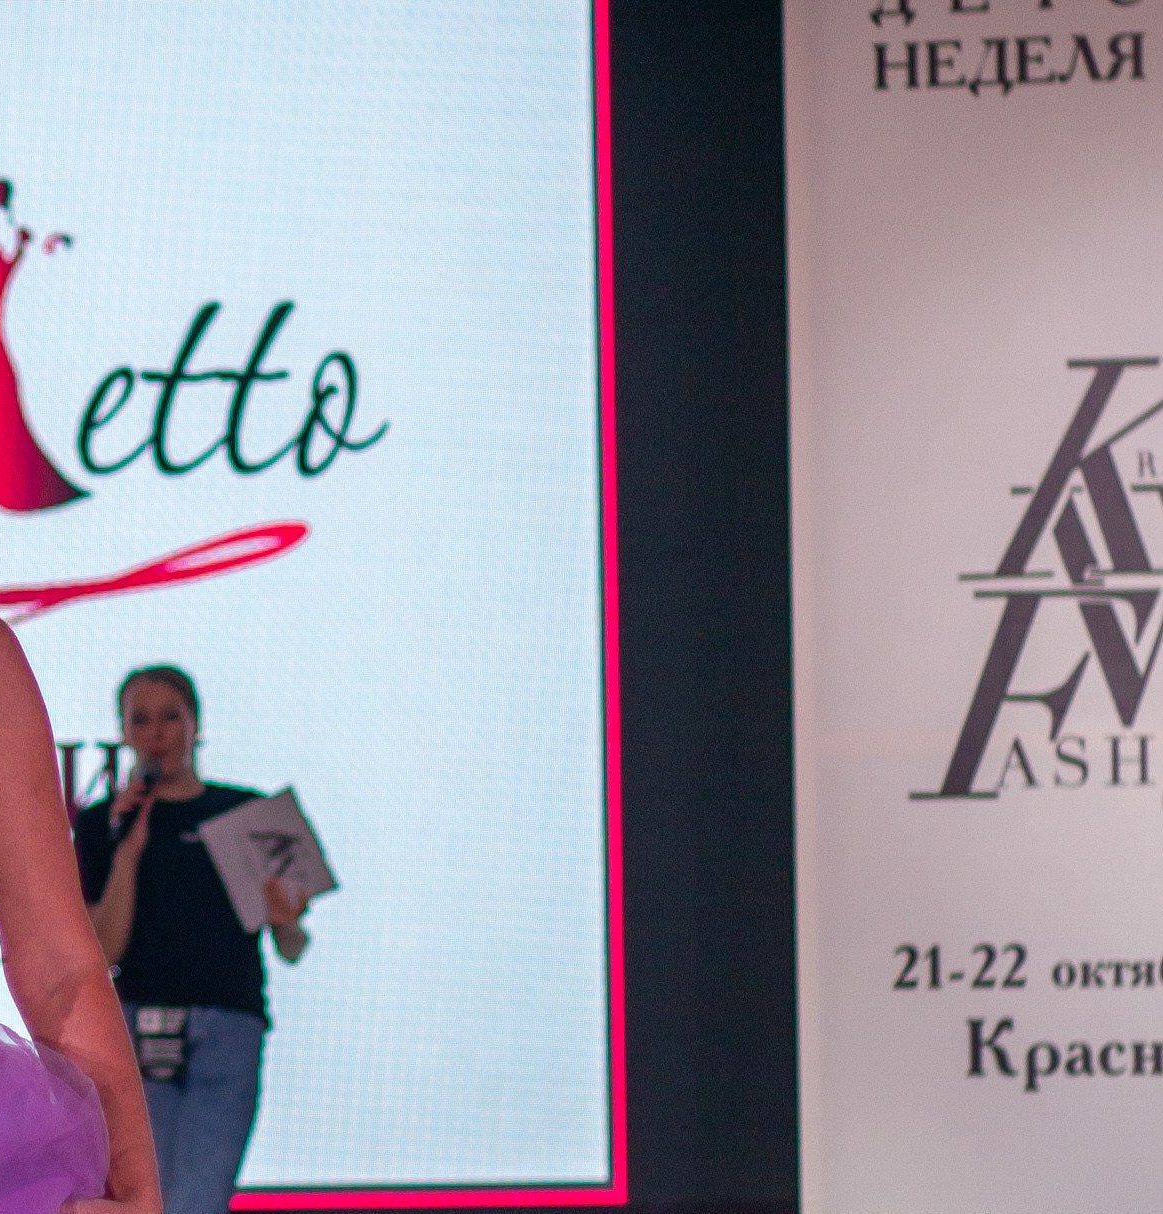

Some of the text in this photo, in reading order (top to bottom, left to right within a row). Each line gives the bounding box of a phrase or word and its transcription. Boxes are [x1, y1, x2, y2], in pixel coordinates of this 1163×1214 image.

[873, 32, 1145, 96] НЕДЕЛЯ
[893, 943, 1163, 989] 21-22 октя
[966, 1015, 1163, 1093] Красн
